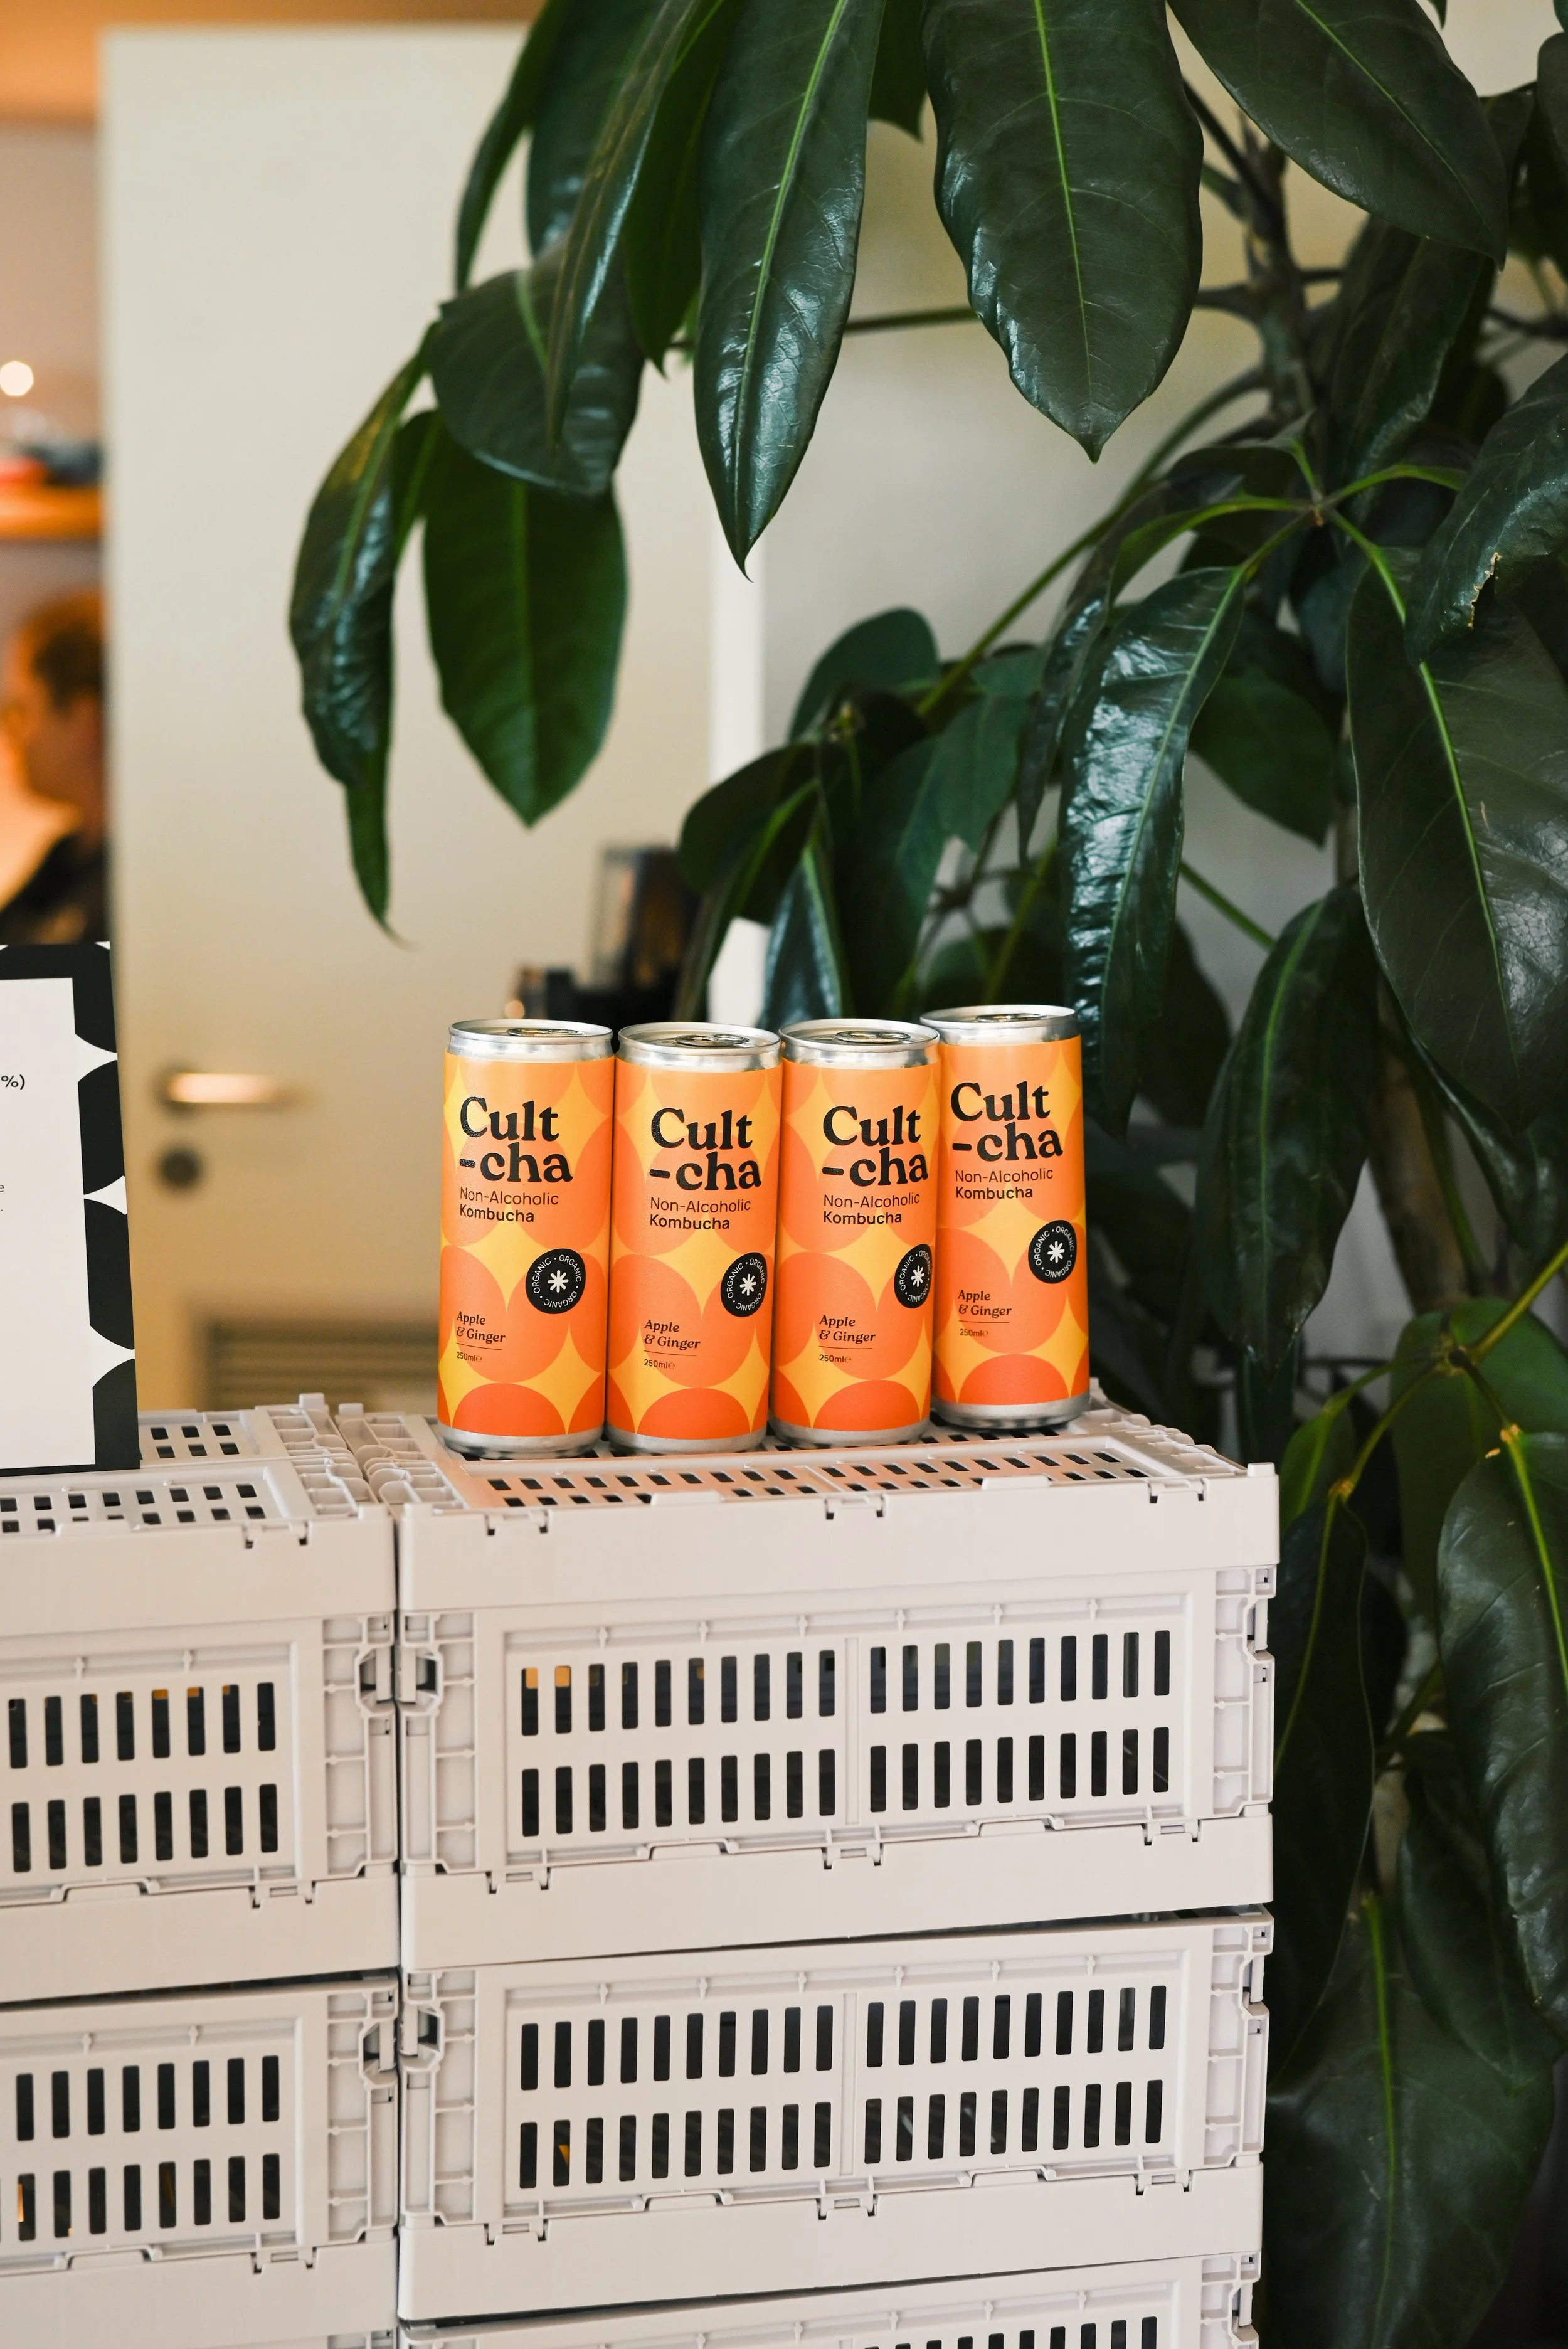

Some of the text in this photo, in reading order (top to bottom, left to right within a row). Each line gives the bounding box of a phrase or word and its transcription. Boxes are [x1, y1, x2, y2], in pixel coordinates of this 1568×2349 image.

[950, 1081, 1050, 1122] Cult
[460, 1096, 559, 1141] Cult
[823, 1106, 921, 1146] Cult
[651, 1107, 753, 1149] Cult
[952, 1122, 1063, 1162] -cha
[460, 1142, 573, 1182] -cha
[822, 1147, 928, 1187] -cha
[650, 1152, 761, 1190] -cha
[955, 1168, 1053, 1182] Non-Alcoholic
[460, 1187, 559, 1206] Non-Alcoholic
[824, 1193, 919, 1208] Non-Alcoholic
[956, 1186, 1033, 1199] Kombucha
[460, 1204, 534, 1222] Kombucha
[650, 1197, 751, 1213] Non-Alcoholic
[650, 1214, 729, 1229] Kombucha
[824, 1211, 902, 1224] Kombucha
[1034, 1226, 1074, 1278] ORGANIC ORGANIC ORGANIC
[532, 1254, 581, 1308] ORGANIC ORGANIC ORGANIC
[899, 1255, 914, 1291] ORGANIC
[726, 1258, 765, 1311] ORGANIC ORGANIC ORGANIC
[958, 1290, 990, 1303] Apple
[457, 1311, 485, 1325] Apple
[958, 1305, 1012, 1318] & Ginger
[644, 1320, 679, 1334] Apple
[819, 1315, 856, 1328] Apple
[457, 1327, 506, 1344] & Ginger
[644, 1334, 701, 1350] & Ginger
[819, 1330, 876, 1344] & Ginger
